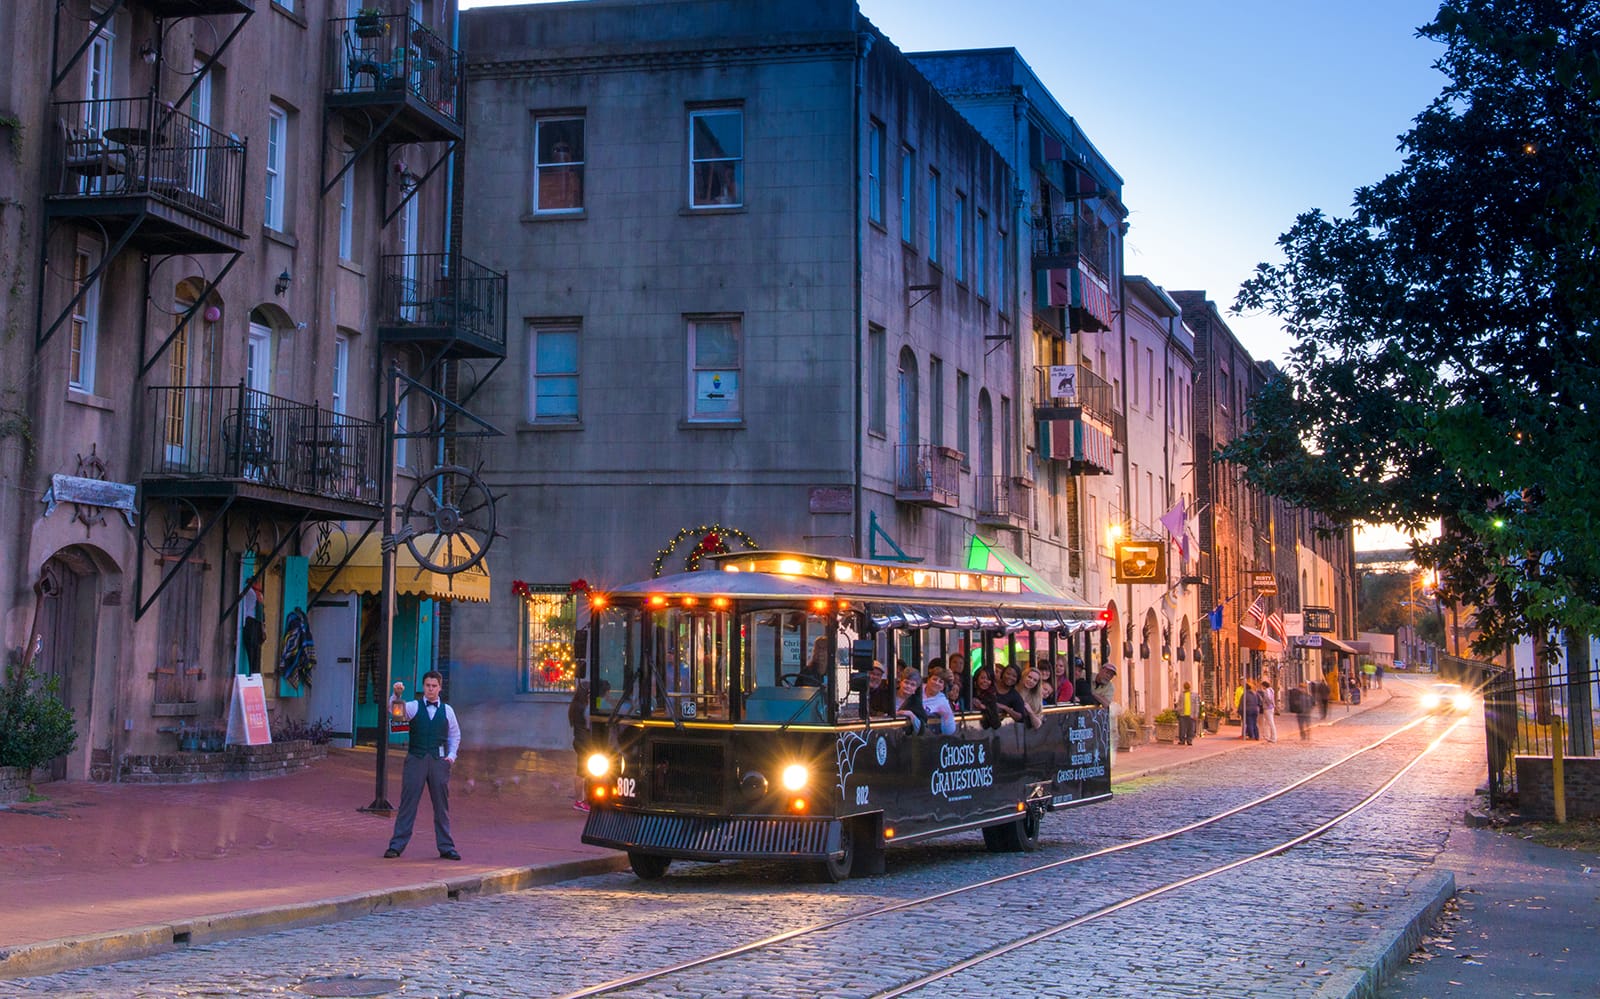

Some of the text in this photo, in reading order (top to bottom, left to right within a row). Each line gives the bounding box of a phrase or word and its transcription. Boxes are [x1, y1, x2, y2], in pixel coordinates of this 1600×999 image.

[683, 704, 695, 715] 126
[940, 743, 985, 769] GHOSTS &
[617, 777, 636, 797] 802
[931, 765, 993, 798] GRAVESTONES
[856, 785, 869, 806] 802
